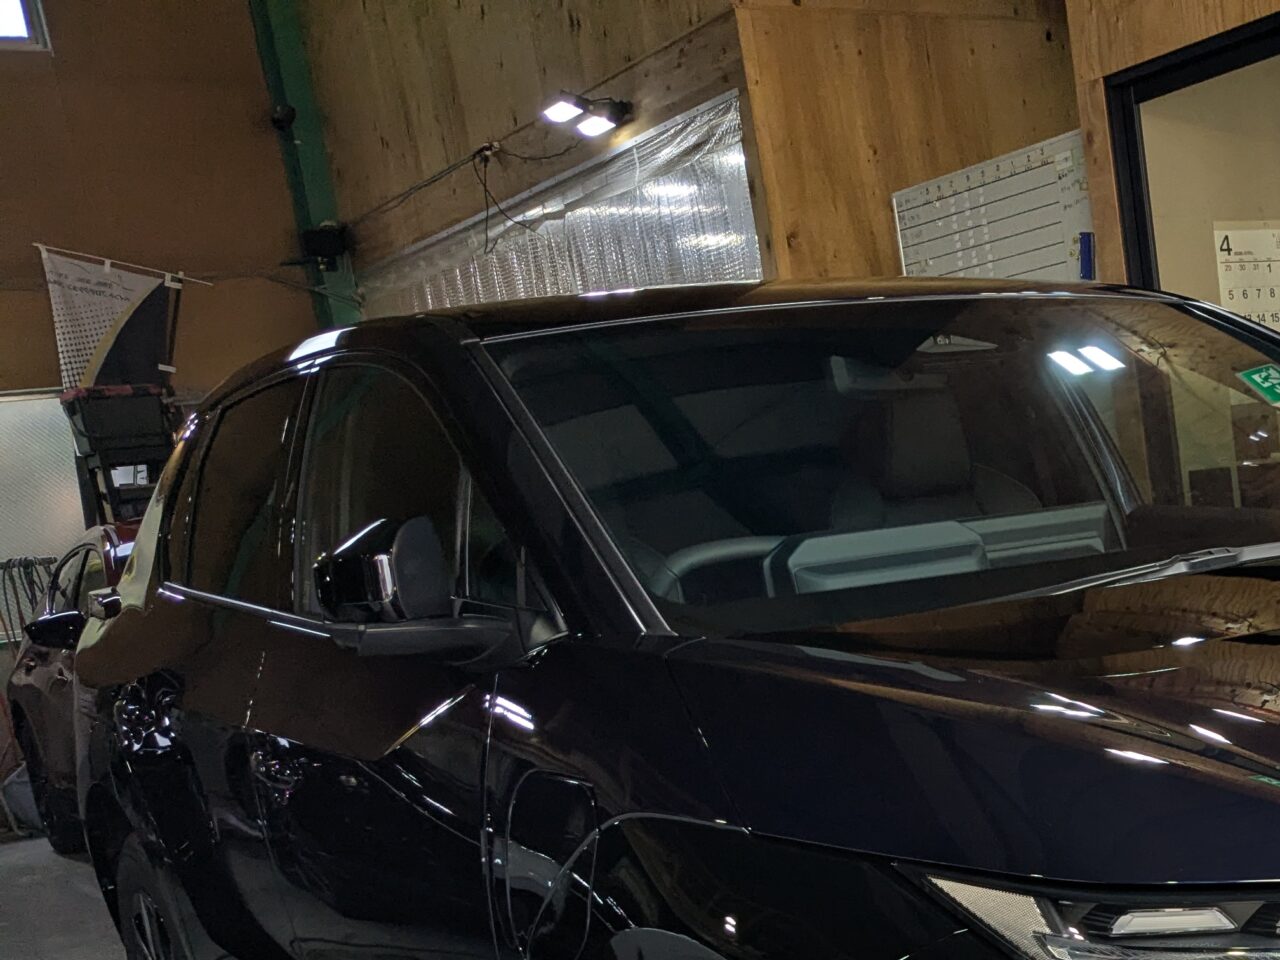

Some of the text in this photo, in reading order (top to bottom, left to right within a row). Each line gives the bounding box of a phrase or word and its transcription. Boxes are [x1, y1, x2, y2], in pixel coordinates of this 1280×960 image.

[1220, 235, 1232, 256] 4
[1267, 263, 1272, 272] 1
[1229, 290, 1235, 300] 5
[1242, 290, 1248, 299] 6
[1256, 289, 1261, 298] 7
[1270, 288, 1275, 298] 8
[1257, 314, 1266, 323] 14
[1270, 313, 1280, 322] 15
